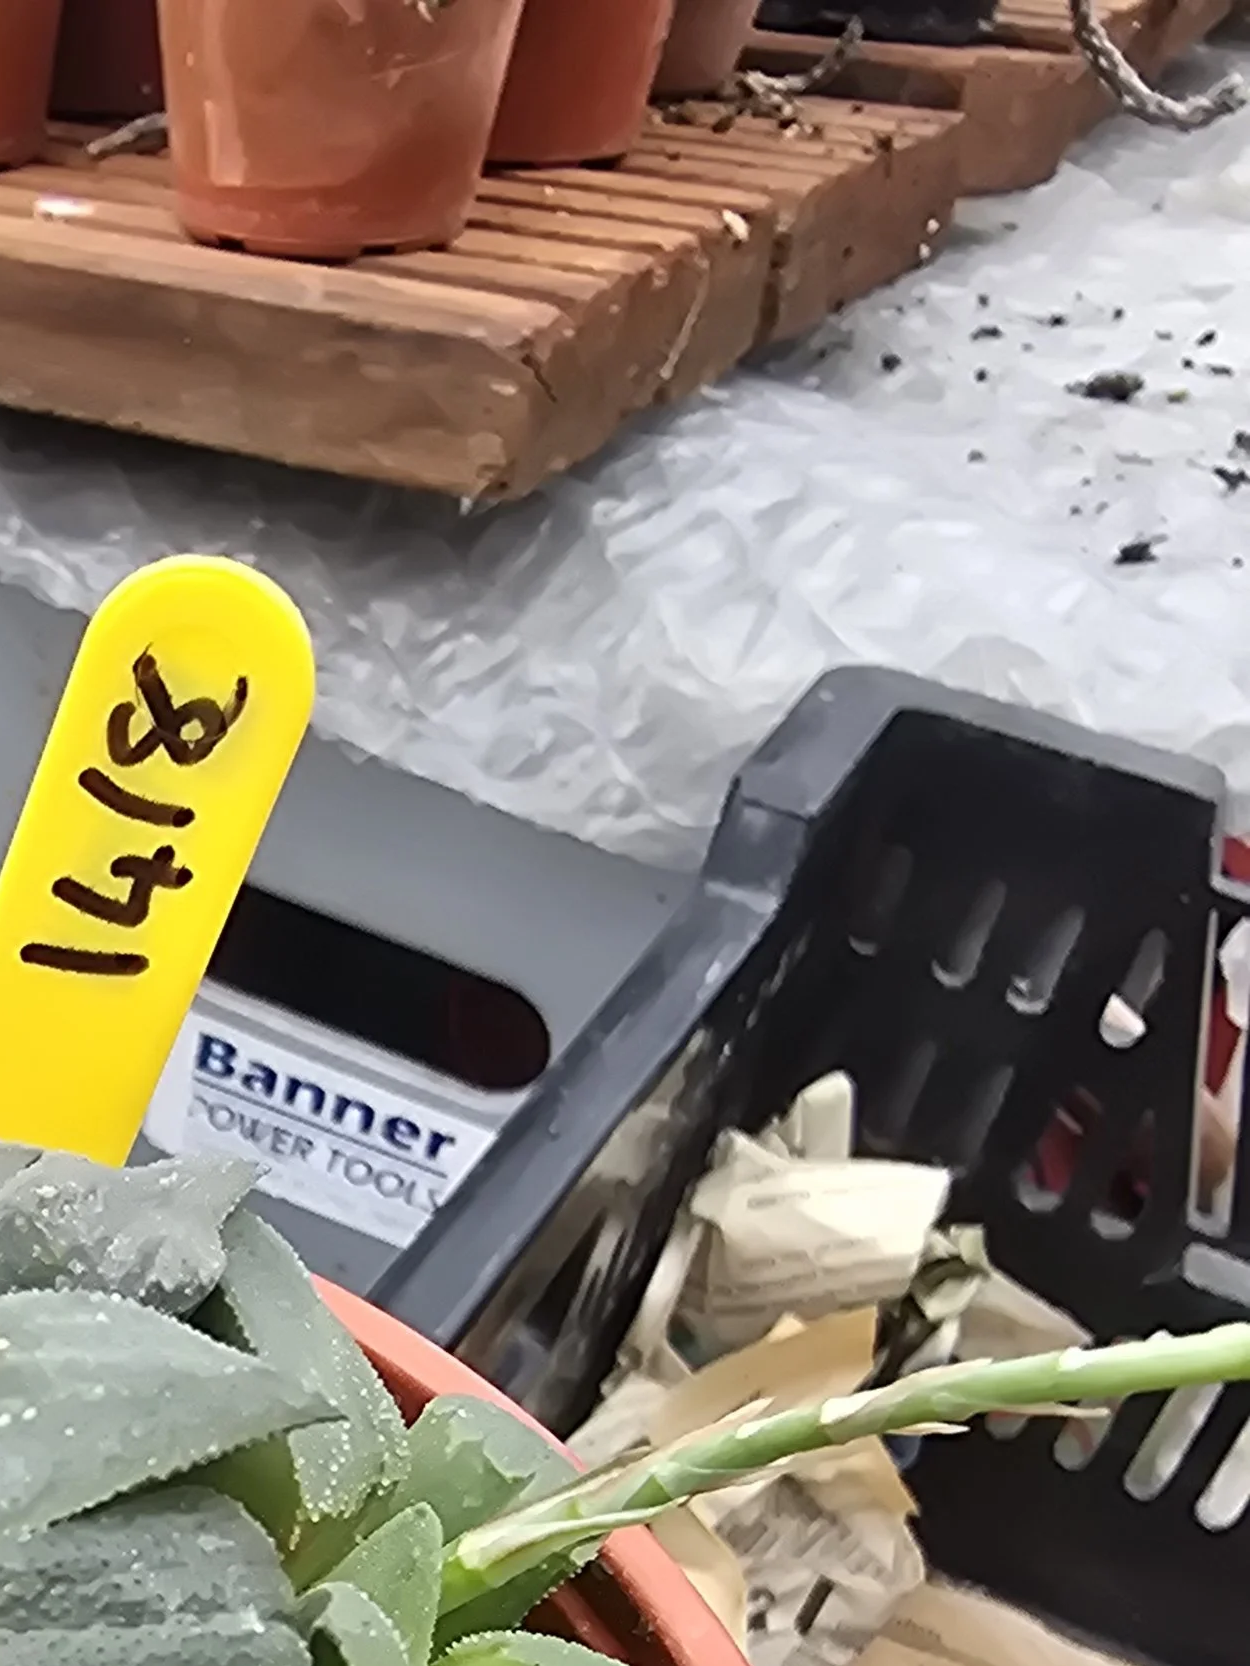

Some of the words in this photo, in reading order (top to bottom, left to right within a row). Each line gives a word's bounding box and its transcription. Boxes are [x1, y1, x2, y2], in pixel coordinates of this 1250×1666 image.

[187, 1095, 314, 1166] POWER
[325, 1145, 443, 1214] TOOLS
[194, 1030, 457, 1163] Banner
